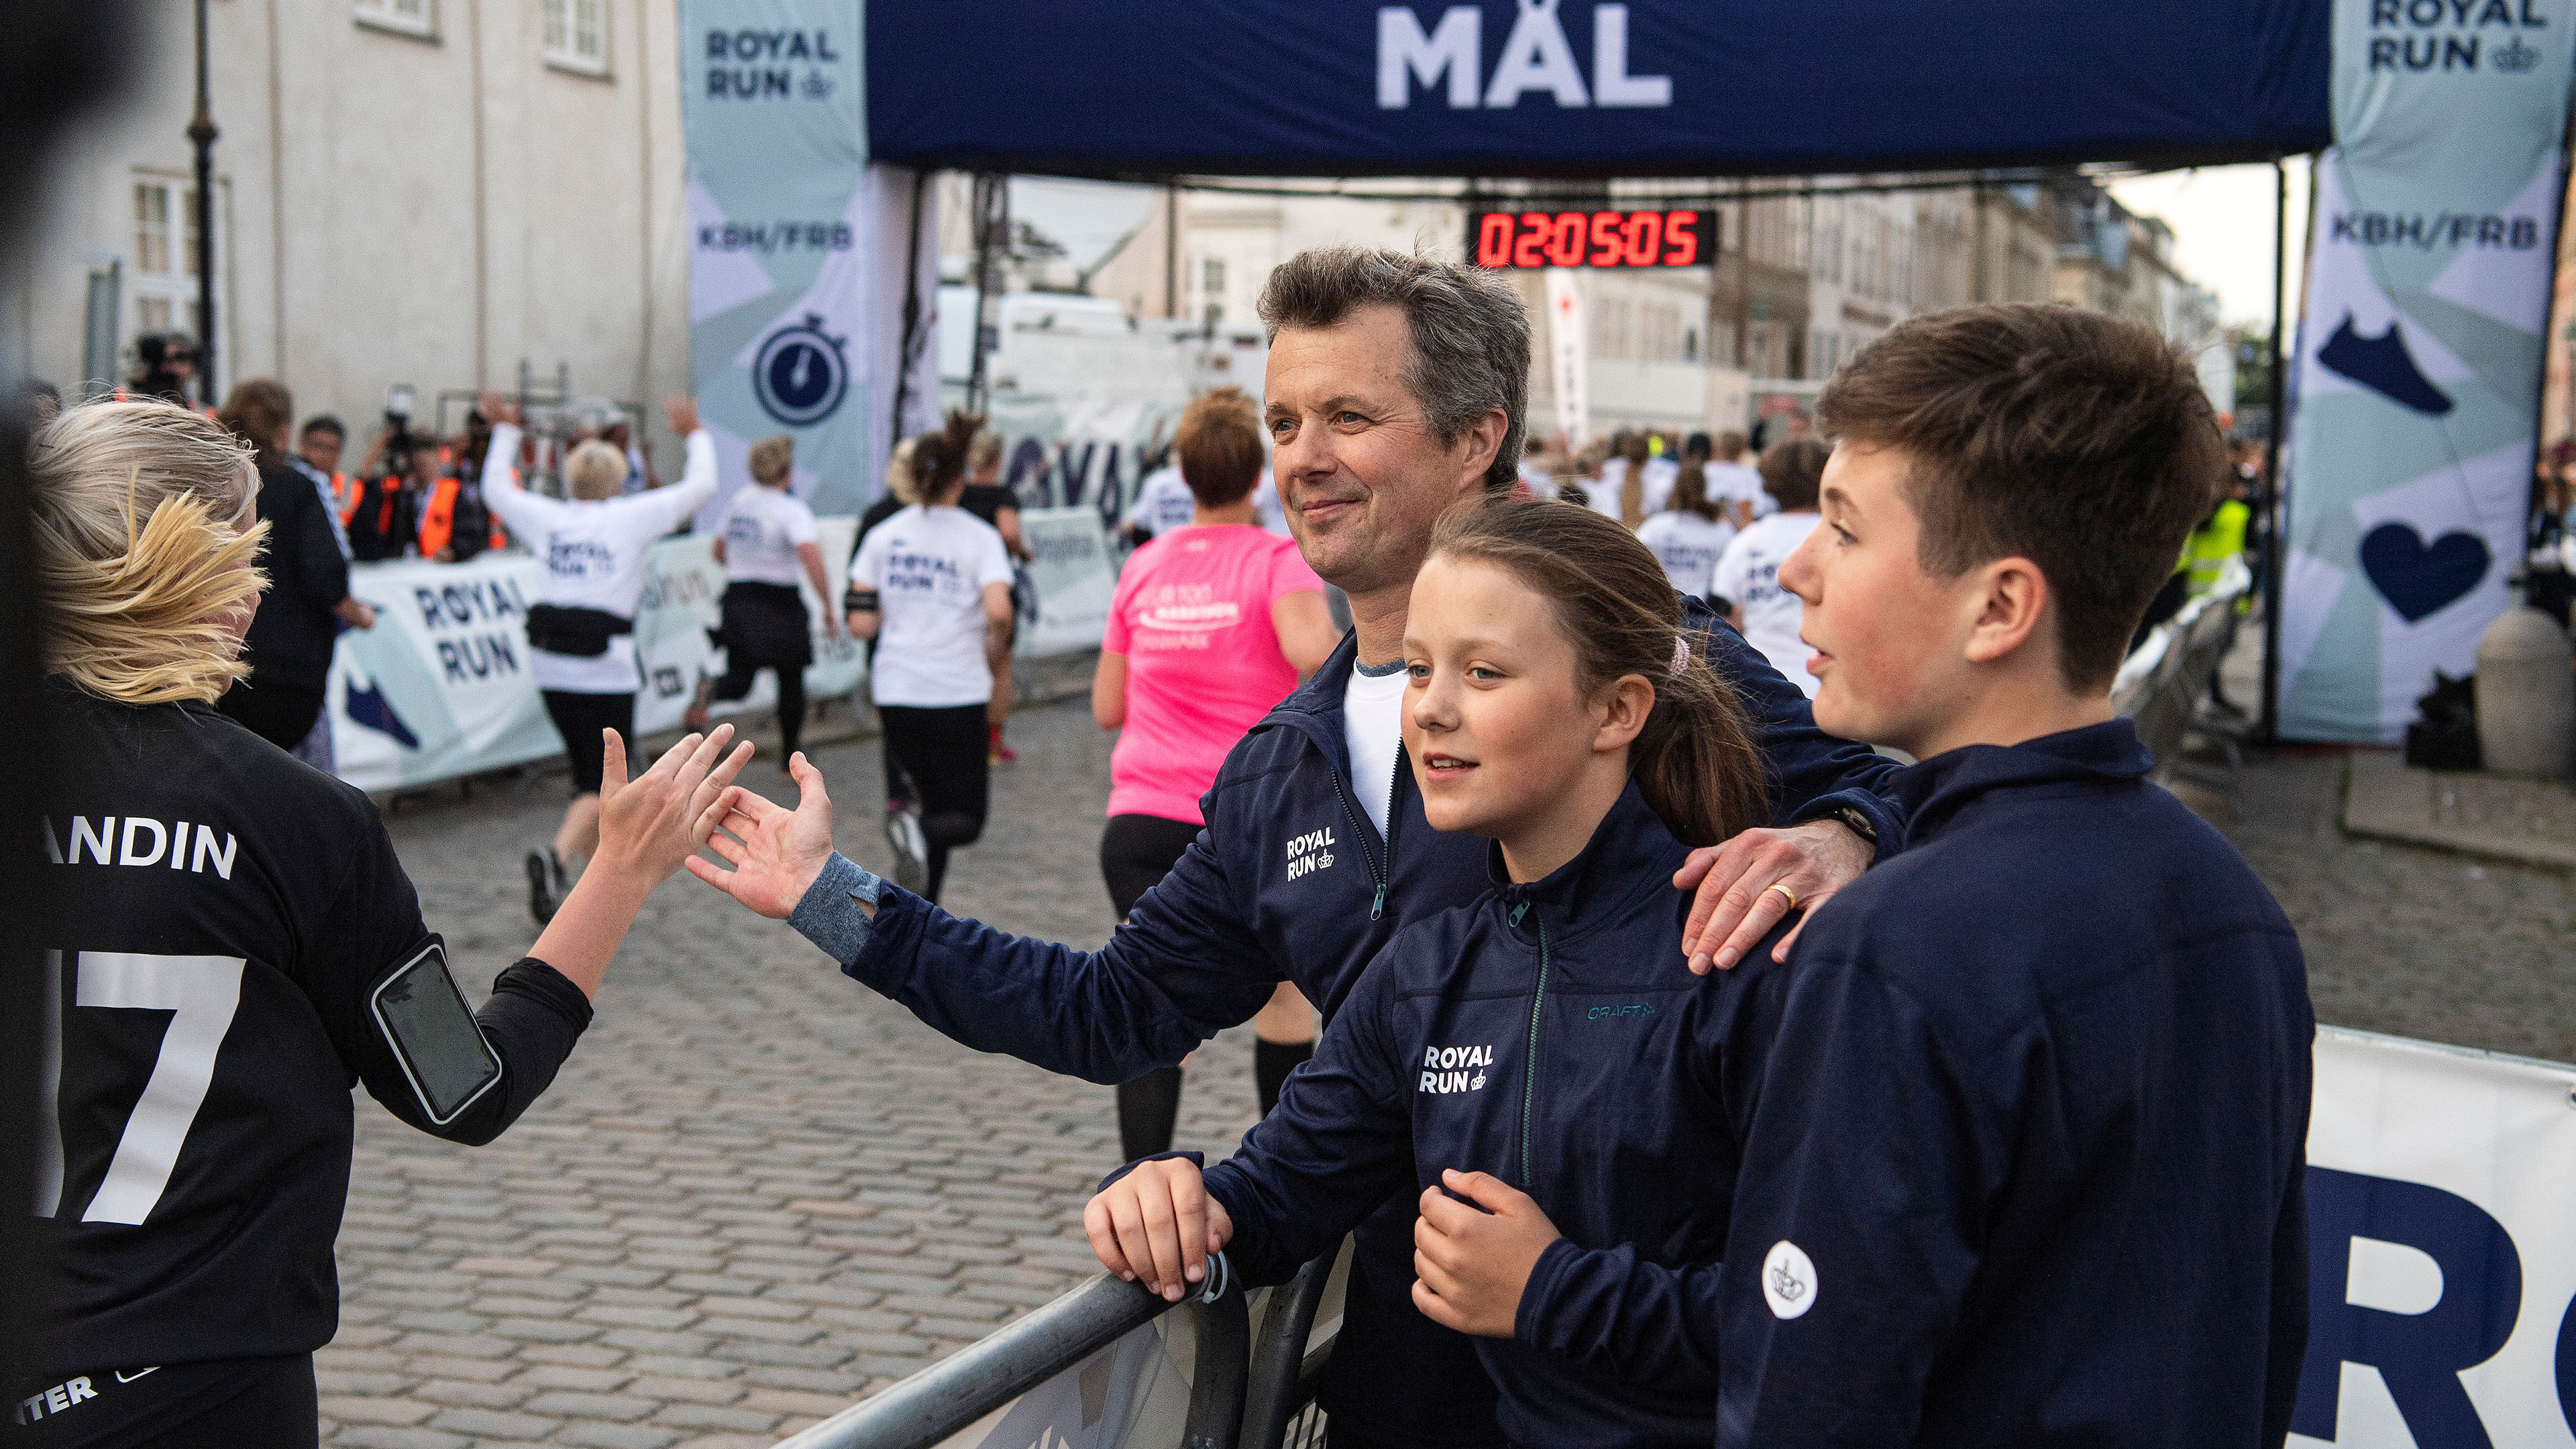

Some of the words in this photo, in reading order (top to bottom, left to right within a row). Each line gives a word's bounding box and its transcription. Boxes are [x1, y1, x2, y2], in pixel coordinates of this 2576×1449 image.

[2369, 0, 2548, 28] ROYAL
[706, 30, 838, 60] ROYAL
[1377, 0, 1673, 109] MÅL
[2369, 36, 2481, 72] RUN
[706, 68, 789, 100] RUN
[698, 222, 854, 252] KBH/FRB
[1477, 211, 1698, 268] 02:05:05
[2332, 209, 2539, 250] KBH/FRB
[414, 578, 527, 631] ROYAL
[437, 630, 520, 685] RUN
[44, 814, 237, 880] NDIN
[1286, 826, 1336, 860] ROYAL
[1287, 852, 1317, 882] RUN
[1424, 1044, 1494, 1069] ROYAL
[1419, 1071, 1468, 1094] RUN
[2282, 1165, 2576, 1449] R
[15, 1375, 99, 1426] TER
